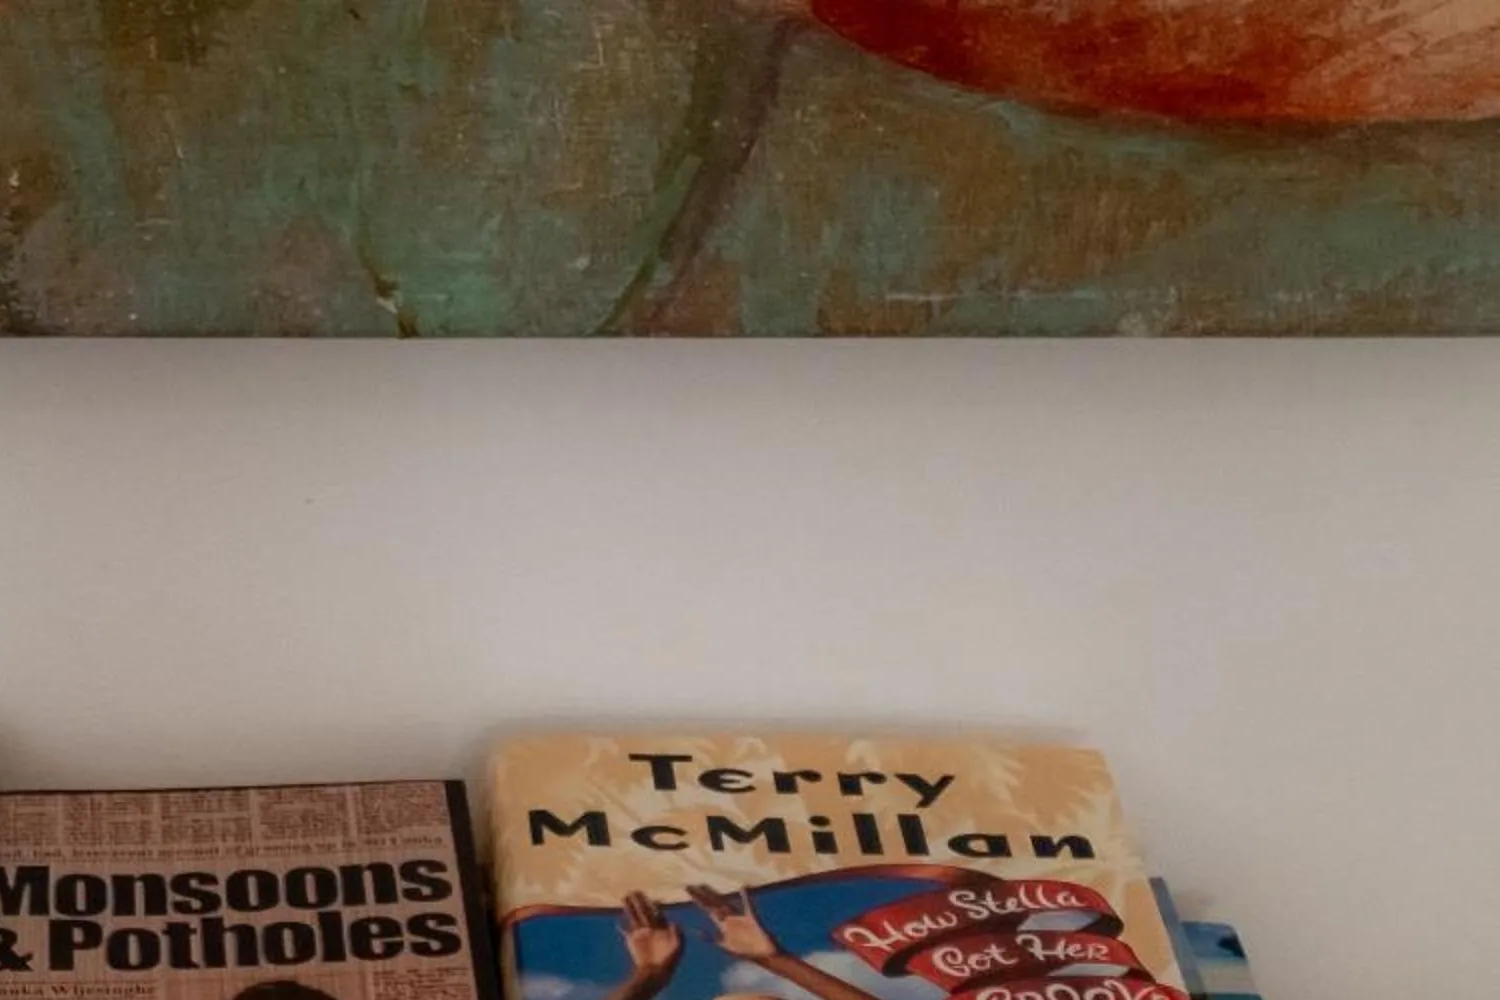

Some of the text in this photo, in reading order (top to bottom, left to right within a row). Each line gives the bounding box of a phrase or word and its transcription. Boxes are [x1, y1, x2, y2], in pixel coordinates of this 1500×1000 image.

[628, 753, 954, 808] Terry
[528, 809, 1095, 858] McMillan
[48, 912, 463, 971] Potholes
[844, 883, 1086, 951] How Stella
